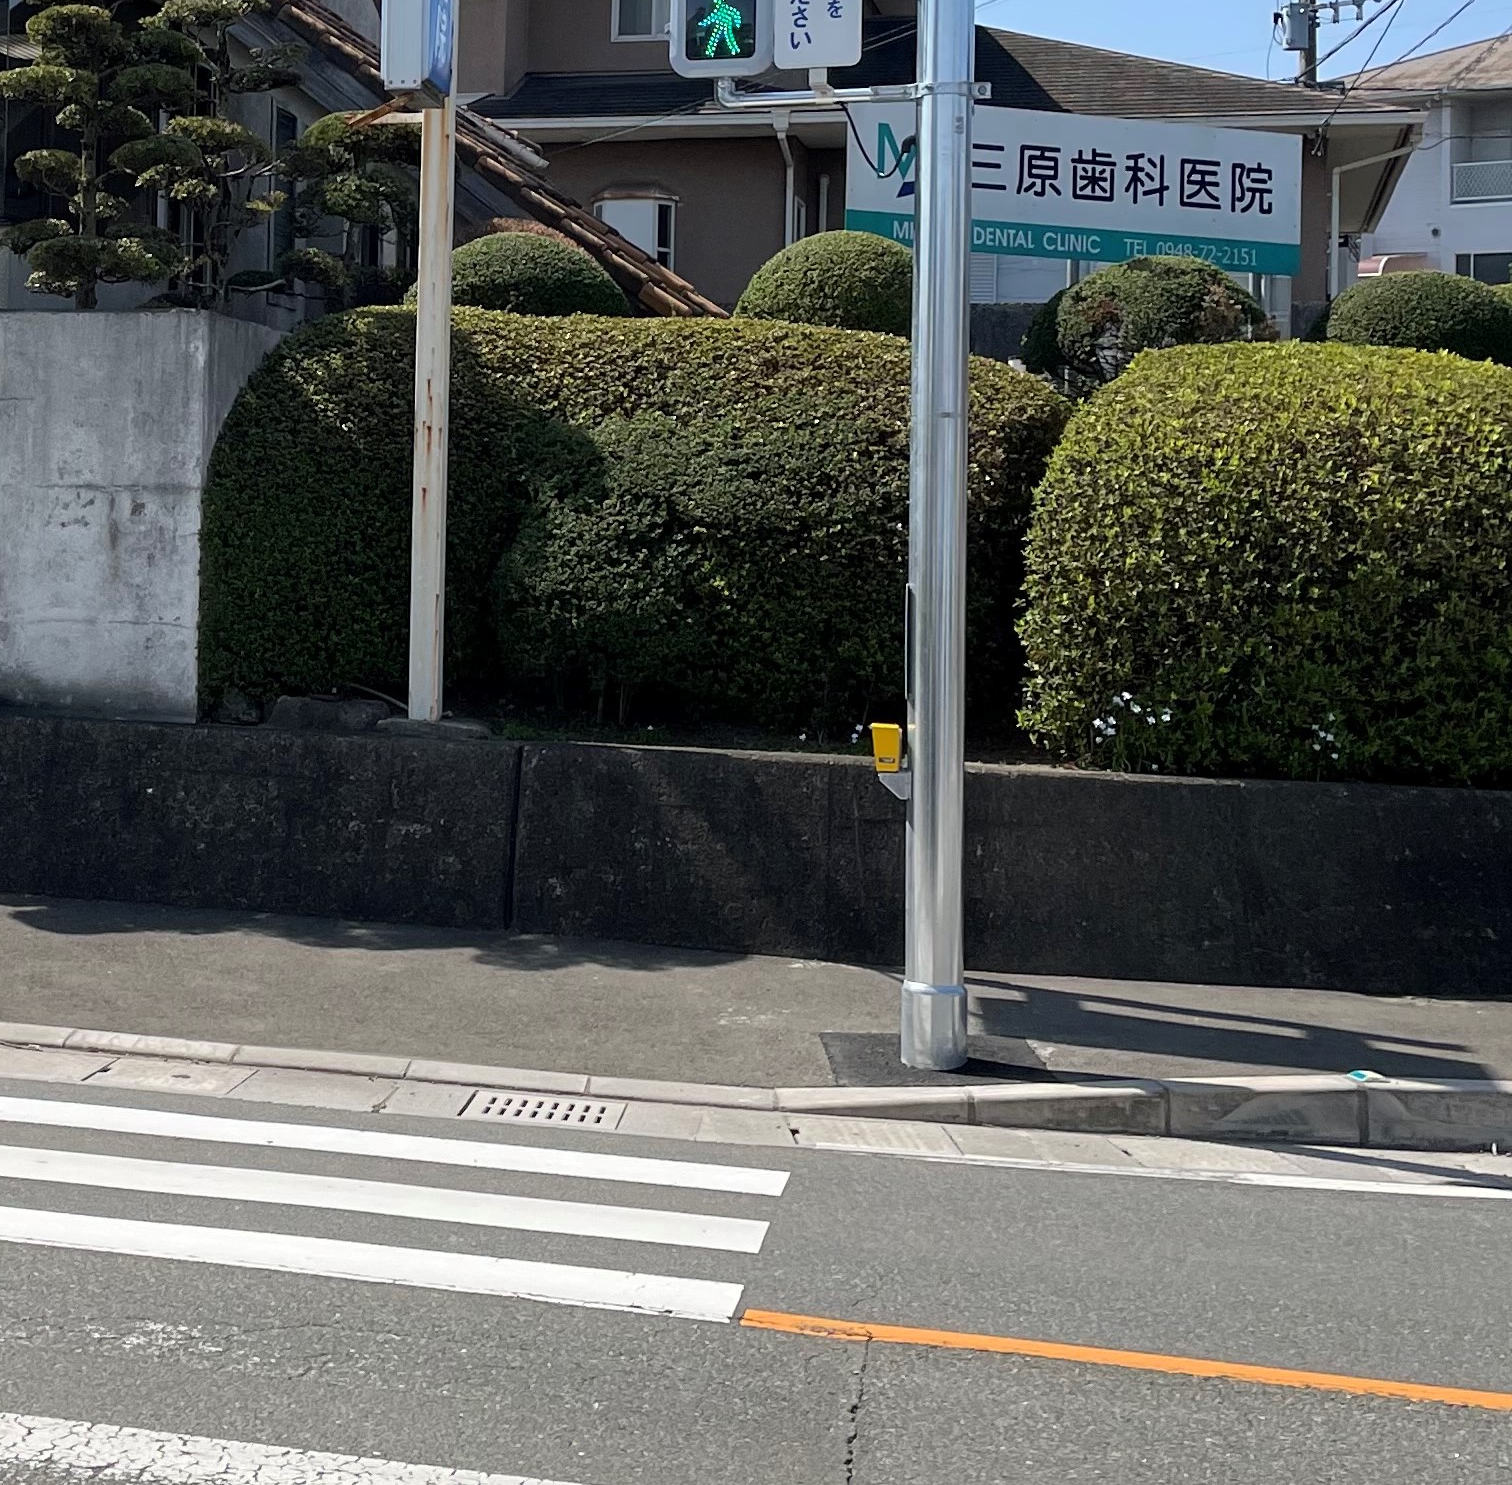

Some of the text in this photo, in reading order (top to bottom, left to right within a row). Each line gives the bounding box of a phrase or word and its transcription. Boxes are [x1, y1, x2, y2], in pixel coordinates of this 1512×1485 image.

[971, 143, 1273, 215] 三原歯科医院
[973, 227, 1101, 254] DENTAL CLINIC
[1123, 238, 1258, 266] TEL 0948-72-2151
